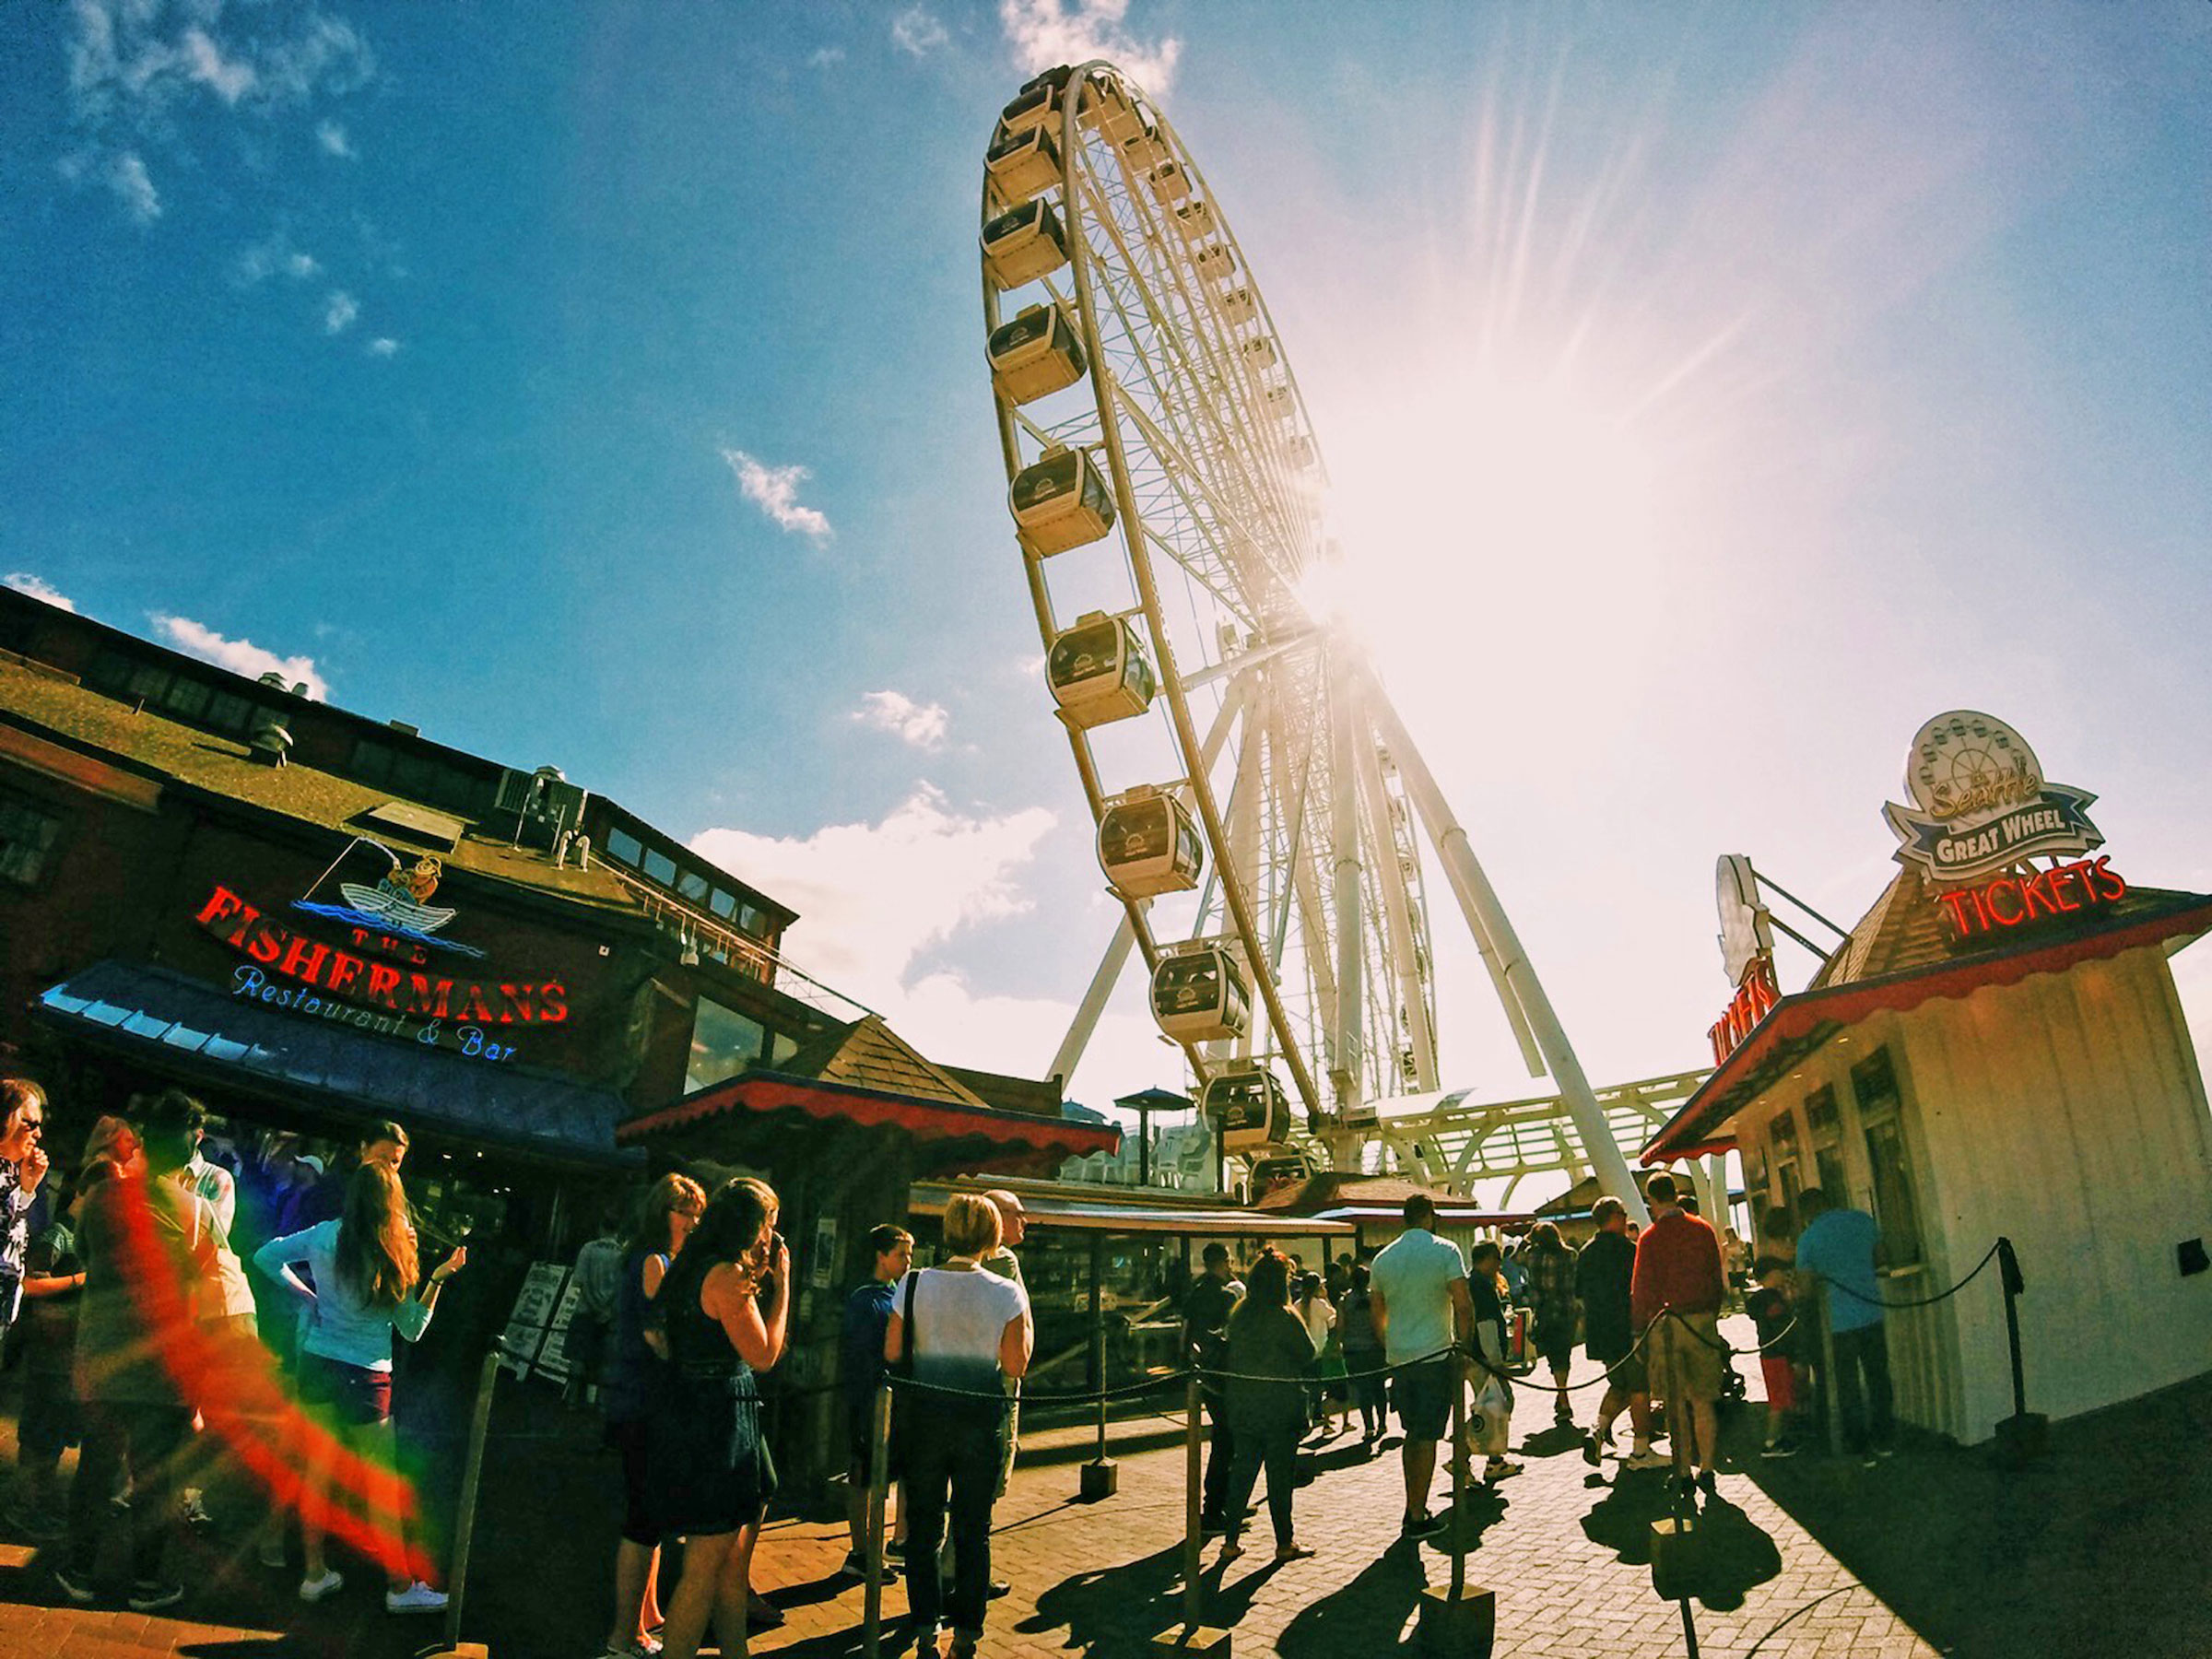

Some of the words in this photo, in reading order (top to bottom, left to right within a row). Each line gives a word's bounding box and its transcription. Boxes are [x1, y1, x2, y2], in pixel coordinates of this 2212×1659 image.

[1931, 769, 2038, 818] Seattle
[1936, 829, 1999, 864] GREAT
[2002, 808, 2066, 842] WHEEL
[1940, 855, 2126, 935] TICKETS
[195, 886, 569, 1022] FISHERMANS
[352, 928, 428, 965] THE
[233, 965, 407, 1036] Restaurant
[418, 1018, 441, 1045] &
[456, 1025, 517, 1062] Bar
